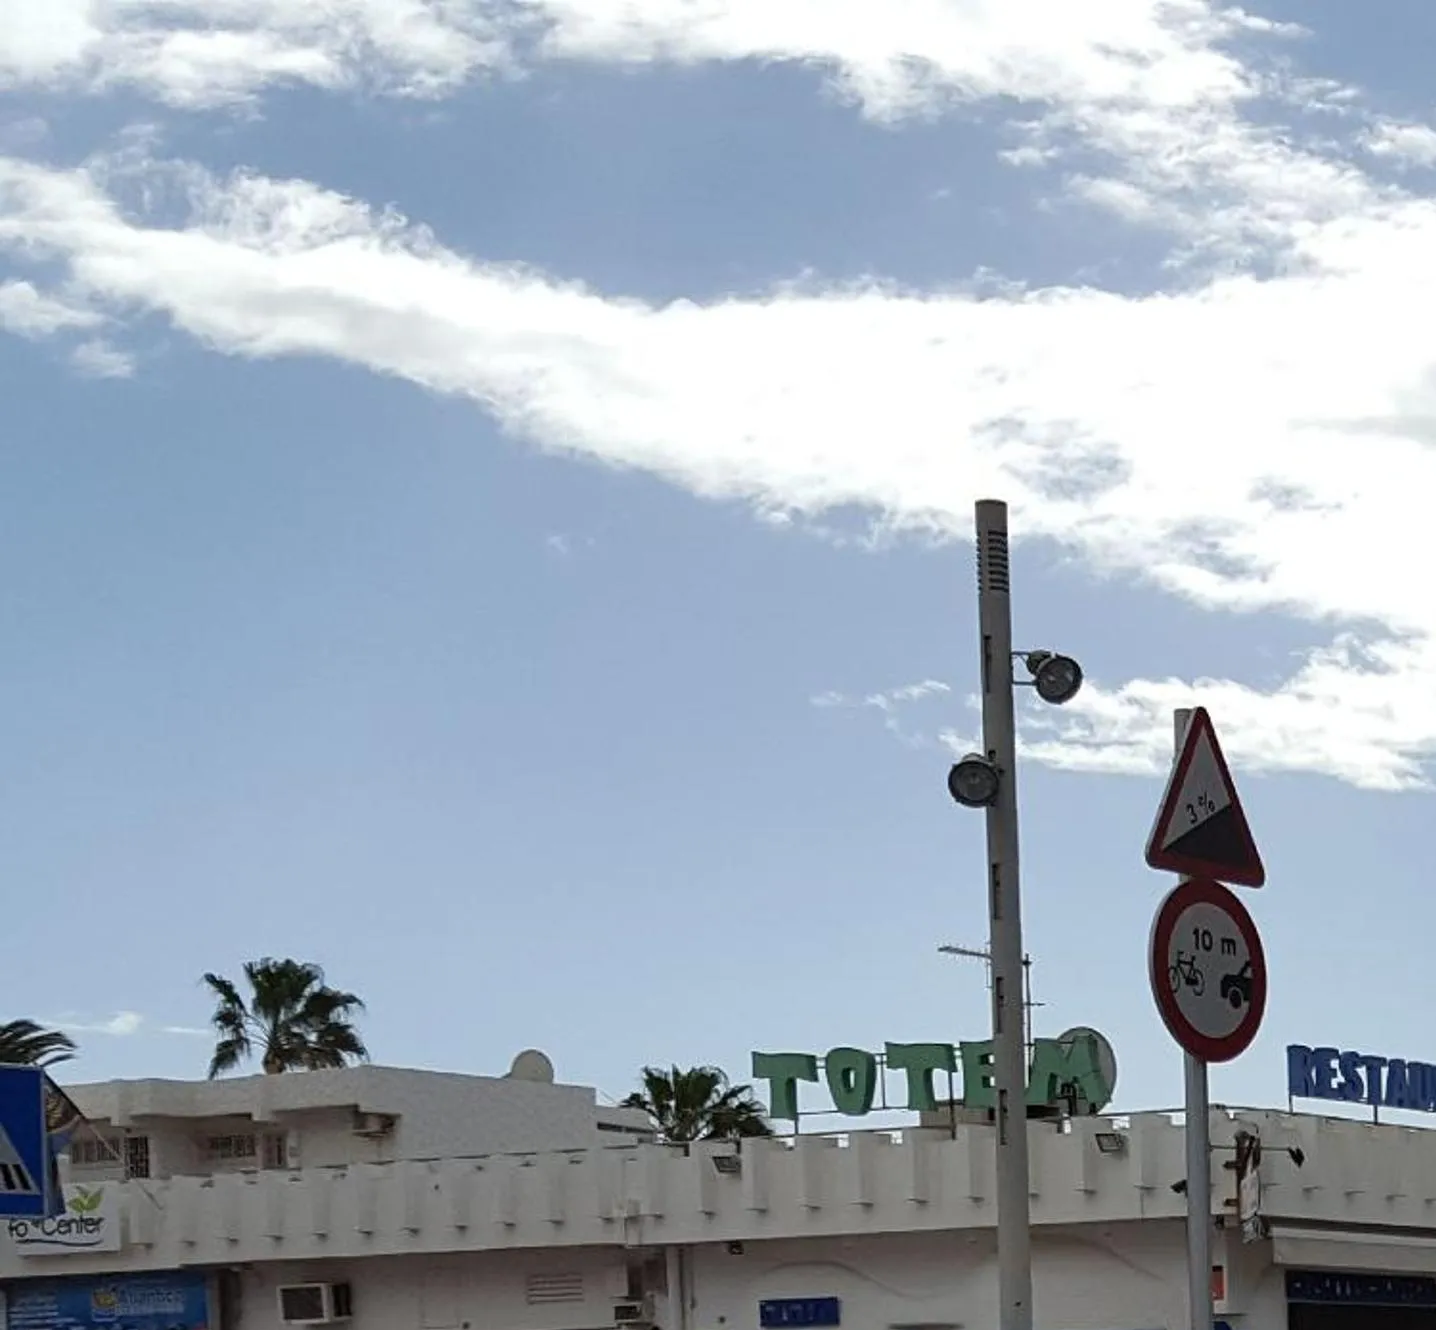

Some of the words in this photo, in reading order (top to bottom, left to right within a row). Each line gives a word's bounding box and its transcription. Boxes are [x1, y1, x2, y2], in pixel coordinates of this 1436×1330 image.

[1192, 928, 1213, 951] 10
[1221, 937, 1237, 956] m
[752, 1035, 1113, 1120] TOTEM
